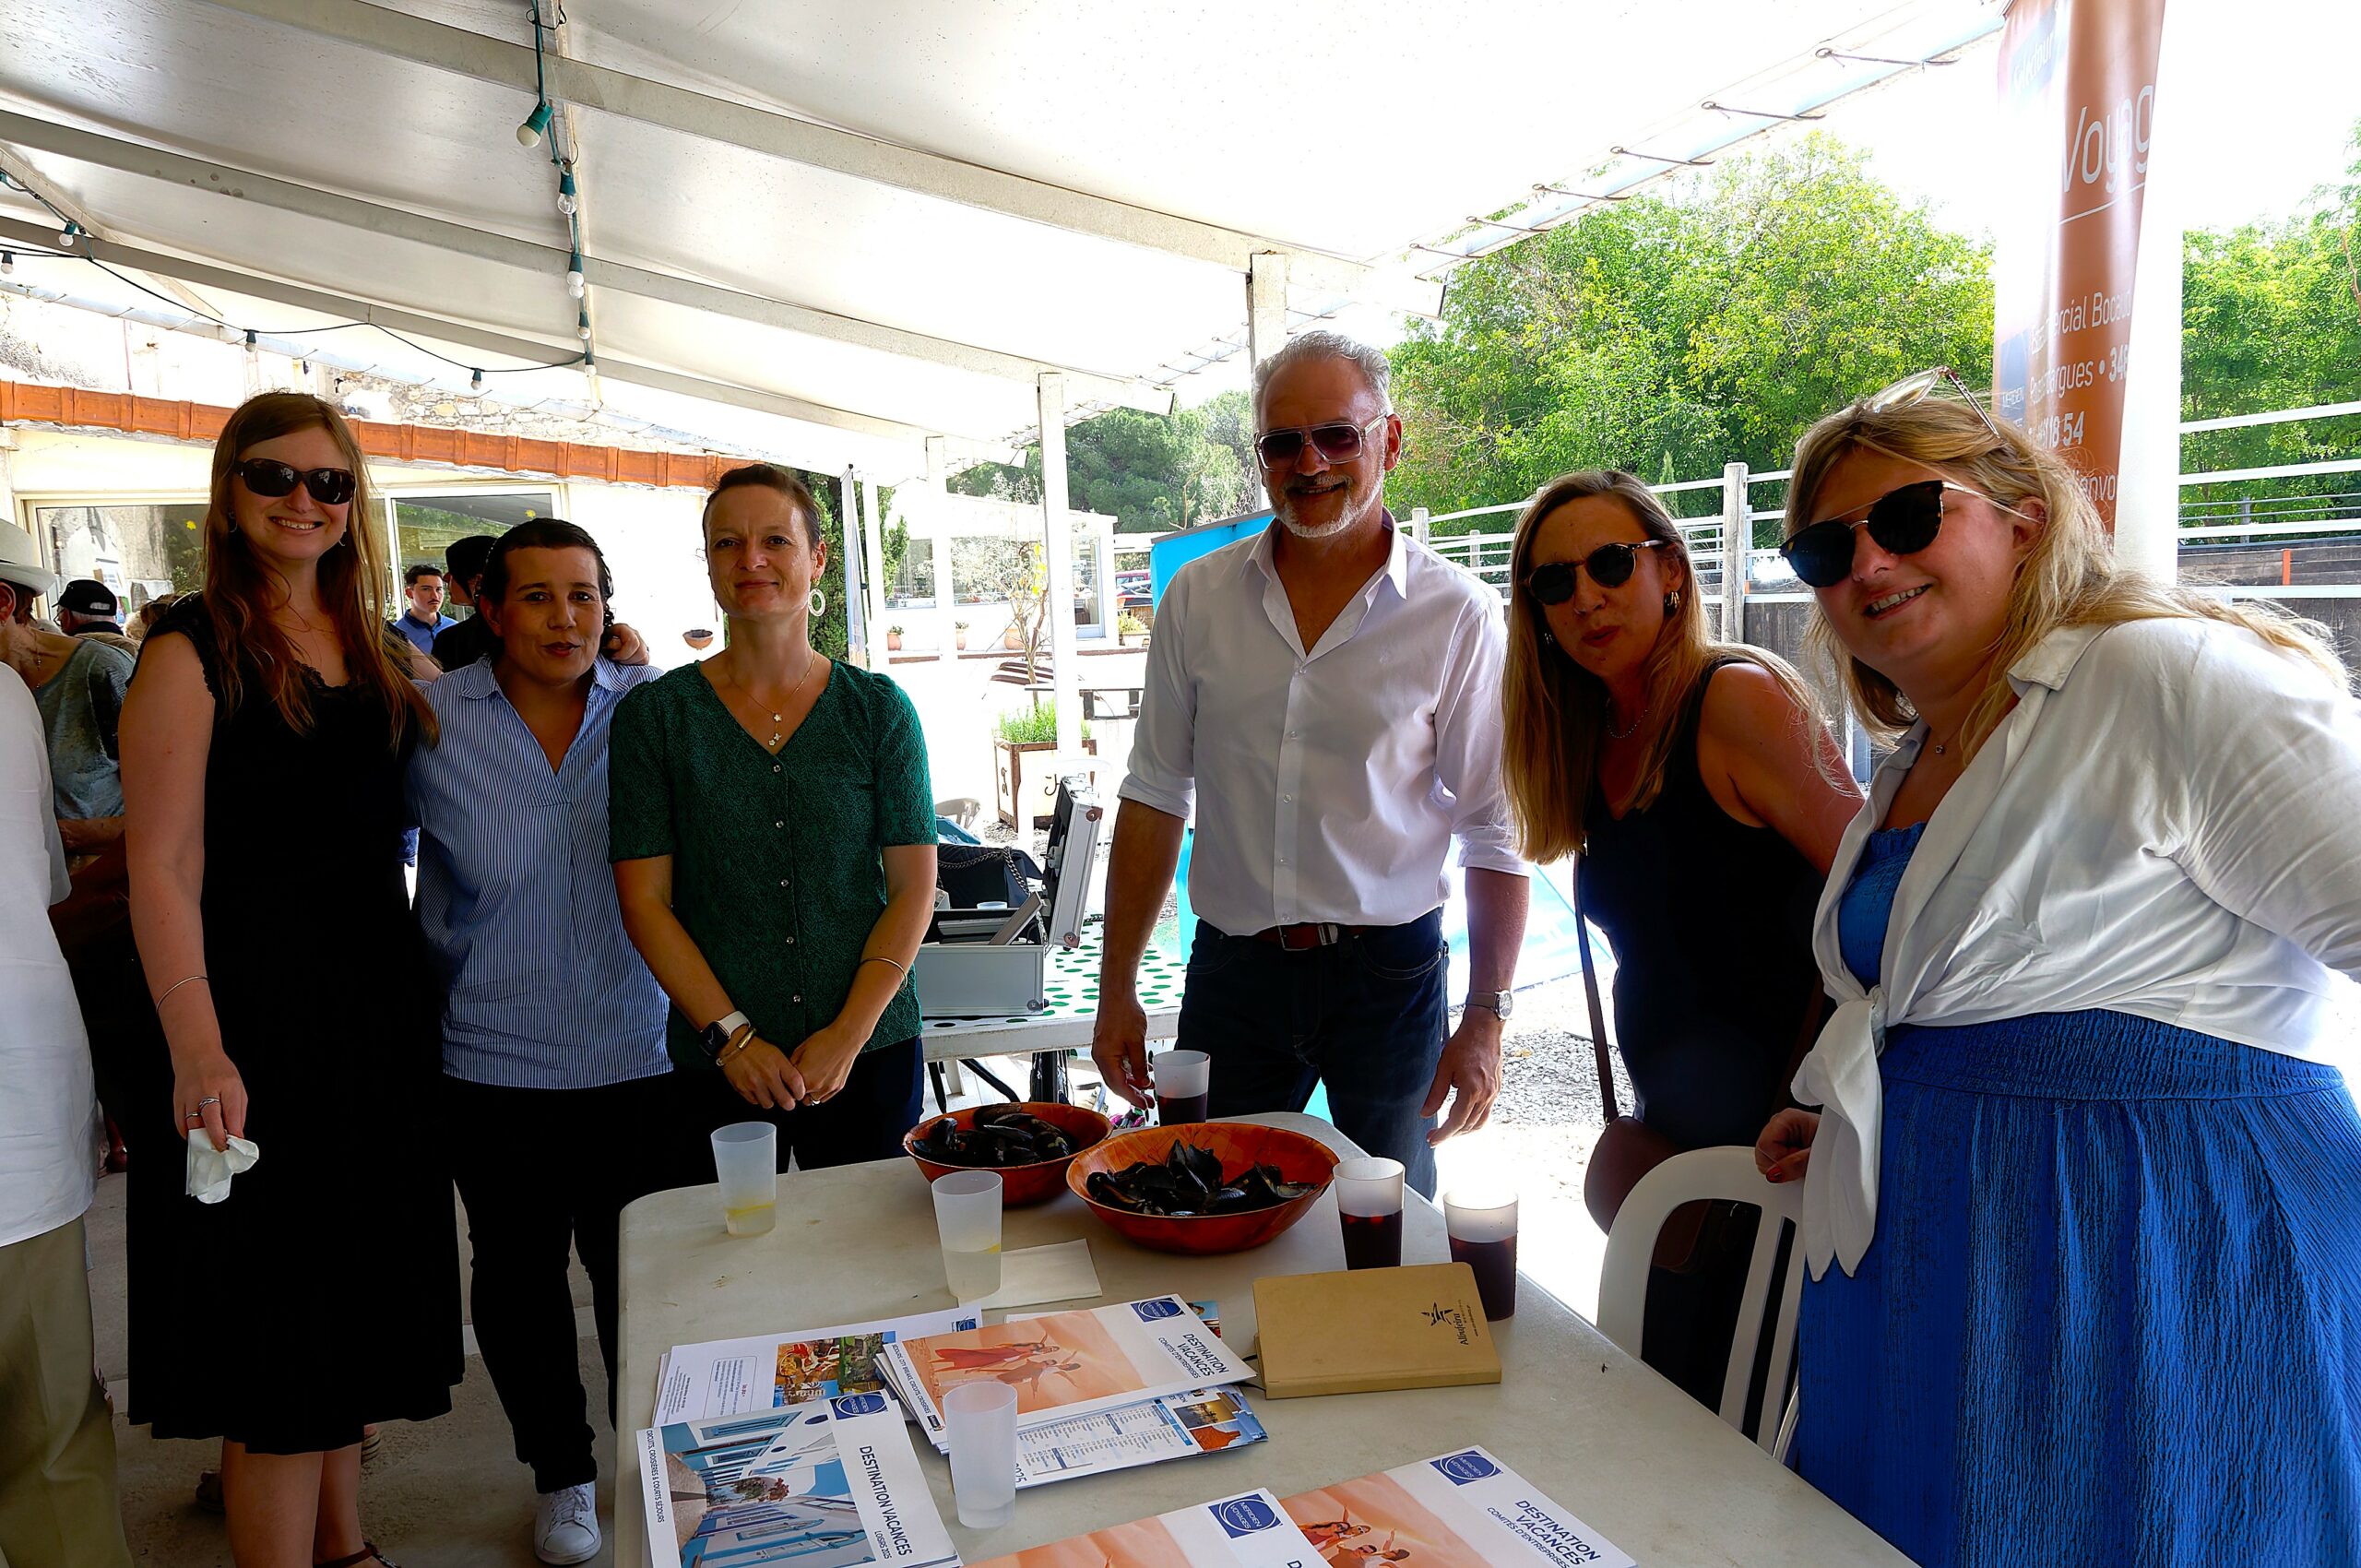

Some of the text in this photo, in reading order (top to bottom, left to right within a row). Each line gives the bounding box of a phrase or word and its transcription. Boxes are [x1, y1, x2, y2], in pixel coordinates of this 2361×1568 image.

[2063, 411, 2084, 446] 54
[1178, 1343, 1215, 1376] VACANCES
[1183, 1334, 1229, 1373] DESTINATION
[860, 1445, 913, 1556] DESTINATION VACANCES
[1487, 1506, 1517, 1530] COMITÉS
[1514, 1500, 1601, 1561] DESTINATION
[1516, 1515, 1586, 1565] VACANCES
